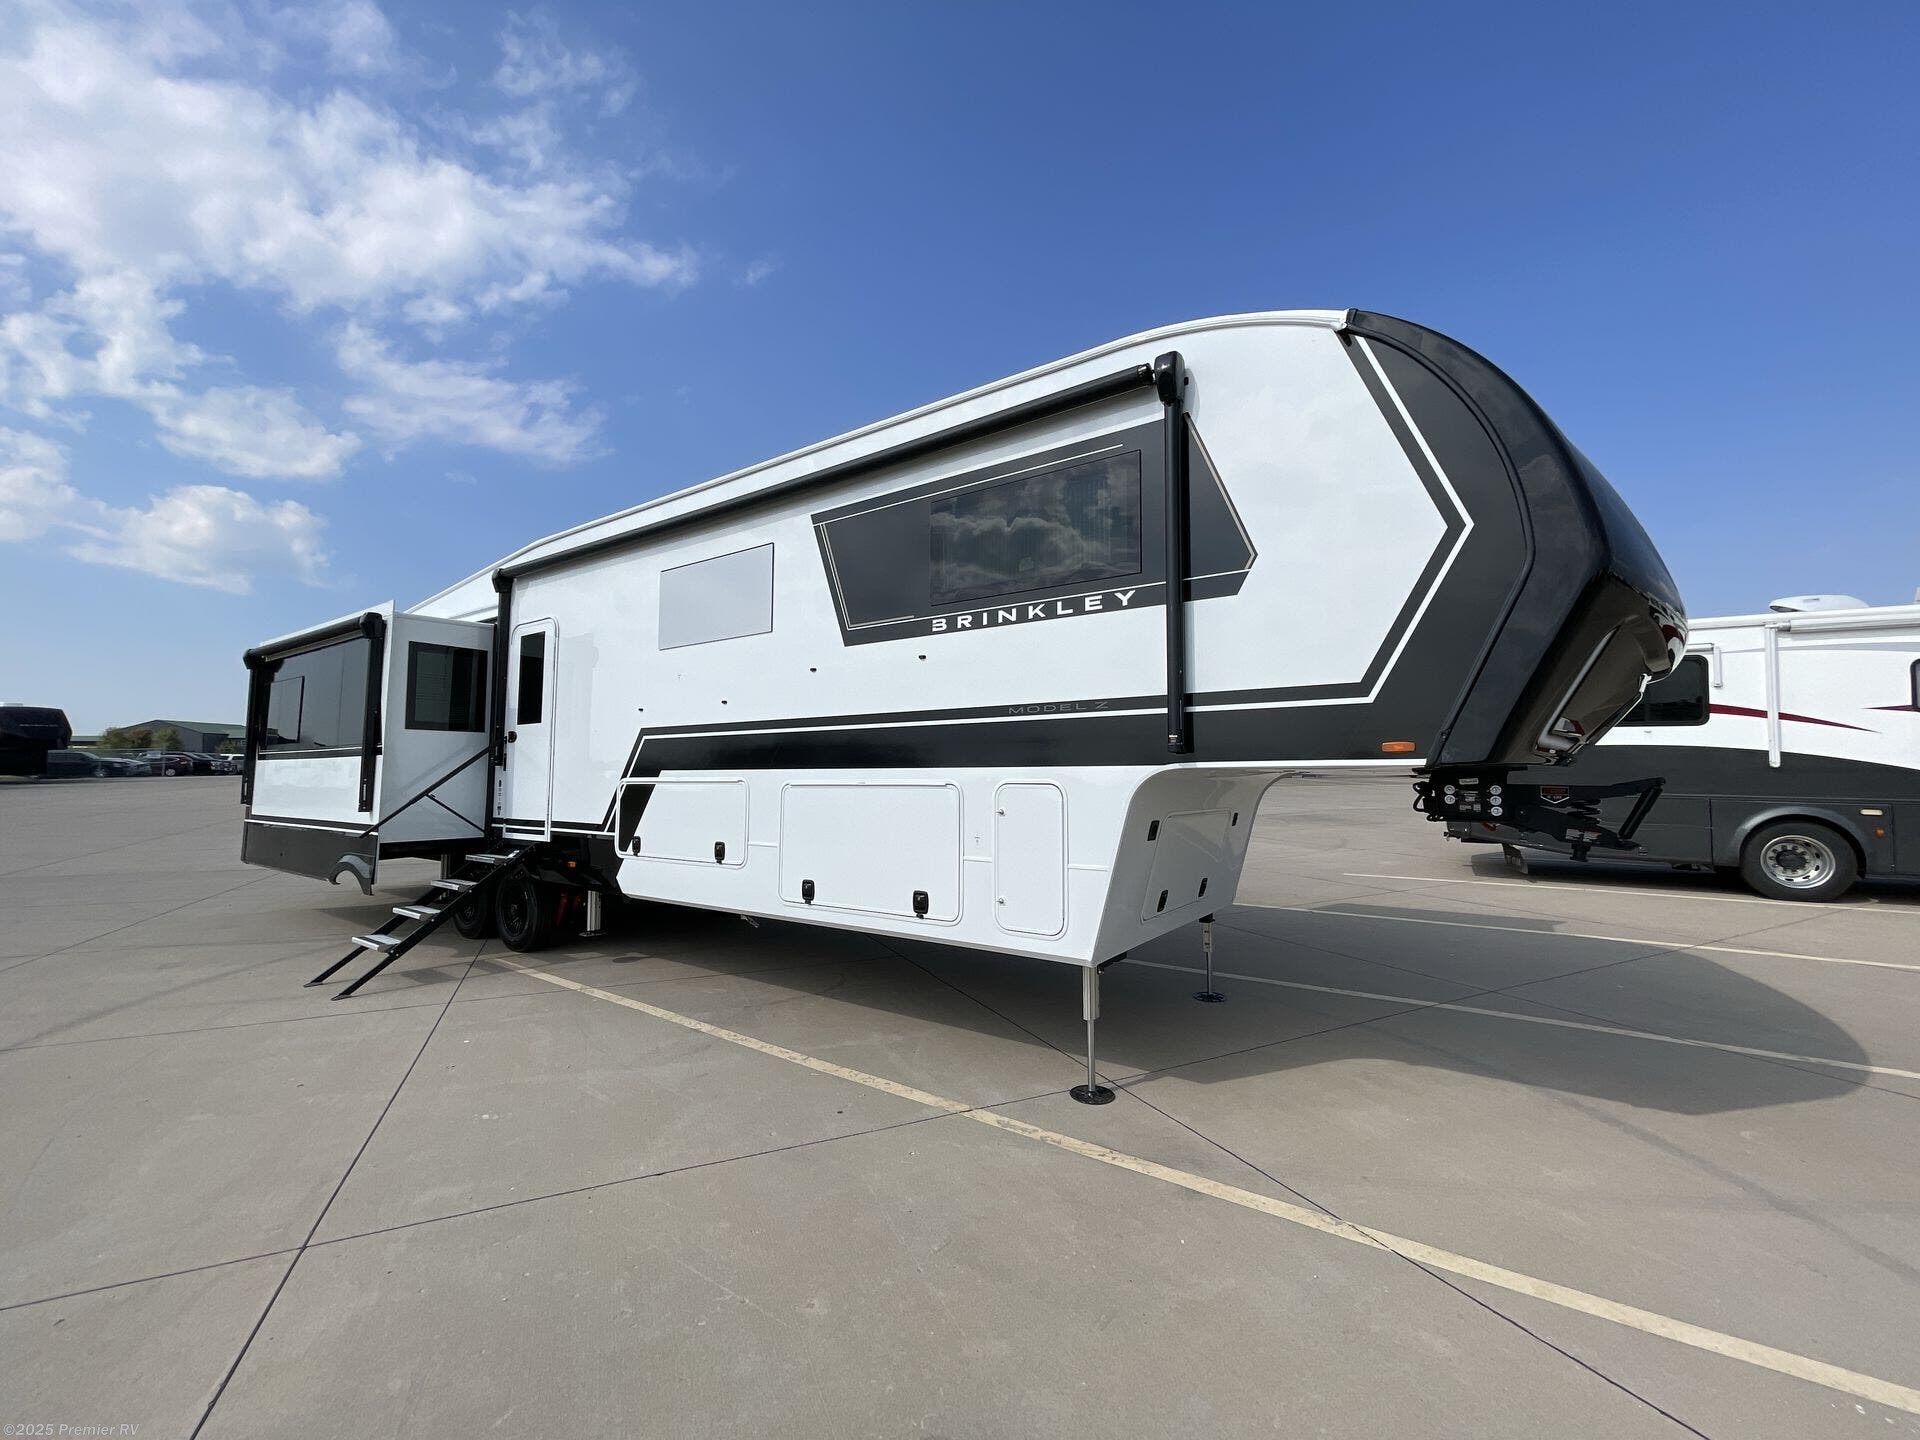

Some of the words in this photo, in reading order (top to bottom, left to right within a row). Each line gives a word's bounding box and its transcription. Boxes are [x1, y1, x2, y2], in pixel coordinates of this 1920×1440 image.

[932, 590, 1136, 631] BRINKLEY
[1008, 703, 1086, 714] MODEL
[1095, 701, 1109, 709] Z
